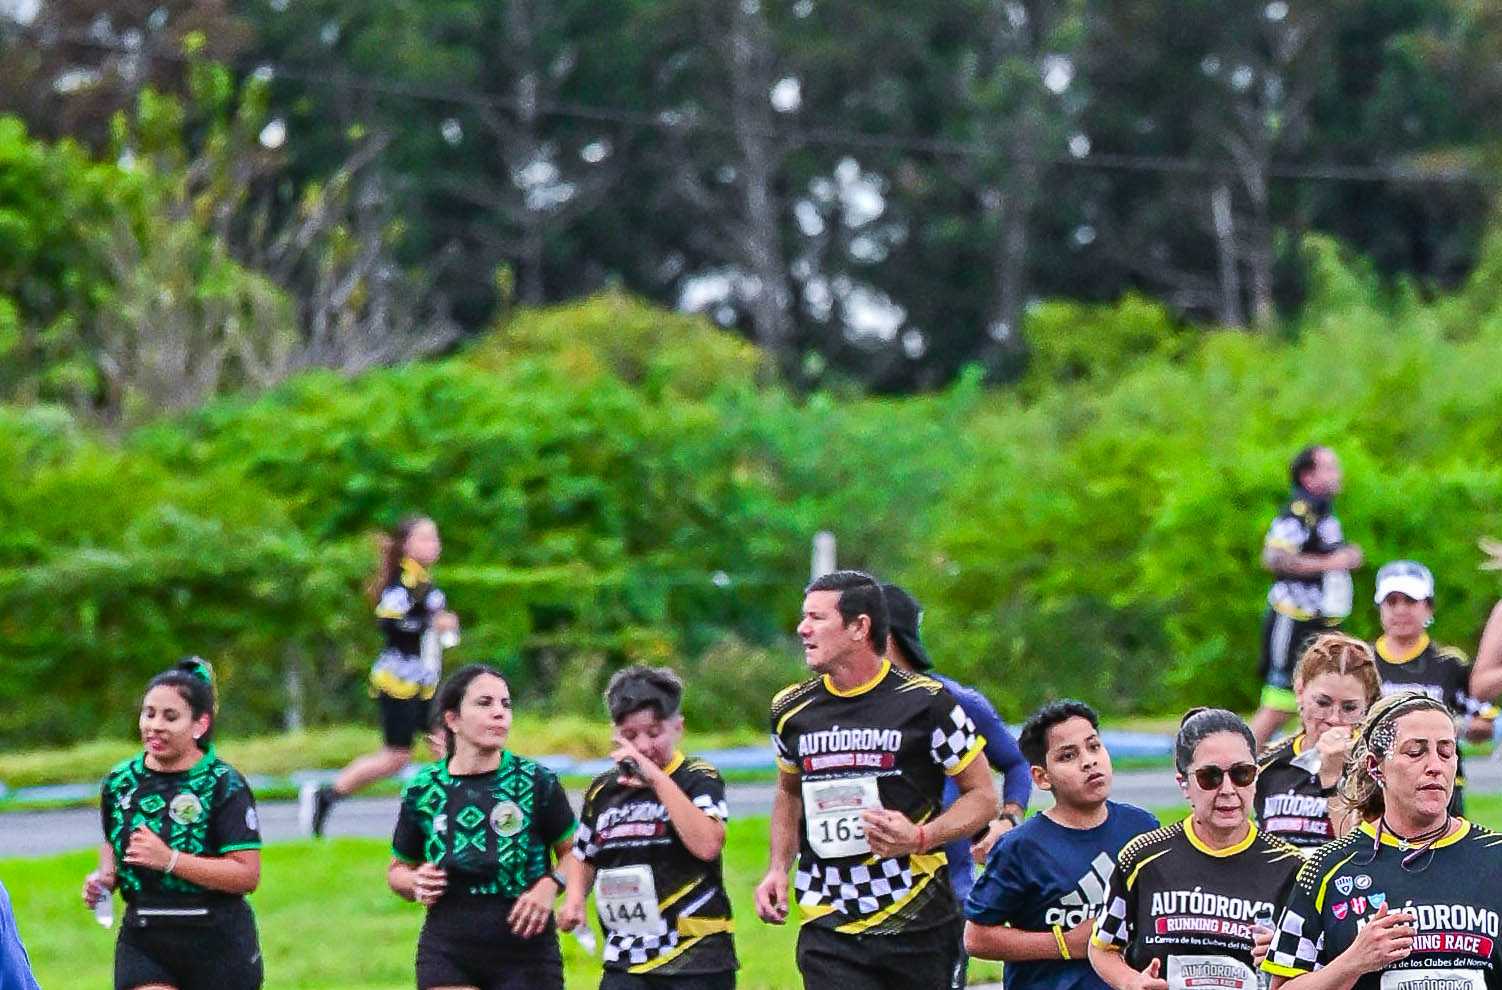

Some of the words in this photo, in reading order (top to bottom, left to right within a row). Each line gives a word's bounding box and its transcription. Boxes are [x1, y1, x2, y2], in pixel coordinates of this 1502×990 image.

[798, 725, 902, 757] AUTÓDROMO
[820, 816, 866, 844] 163
[605, 902, 647, 923] 144
[1166, 918, 1219, 932] RUNNING
[1221, 920, 1252, 939] RACE
[1145, 936, 1154, 944] La
[1180, 936, 1190, 944] de
[1410, 934, 1441, 952] NING
[1445, 934, 1481, 953] RACE
[1181, 960, 1248, 980] AUTÓDROMO
[1398, 960, 1409, 968] de
[1410, 959, 1423, 967] los
[1423, 957, 1452, 967] Clubes
[1453, 957, 1466, 966] del
